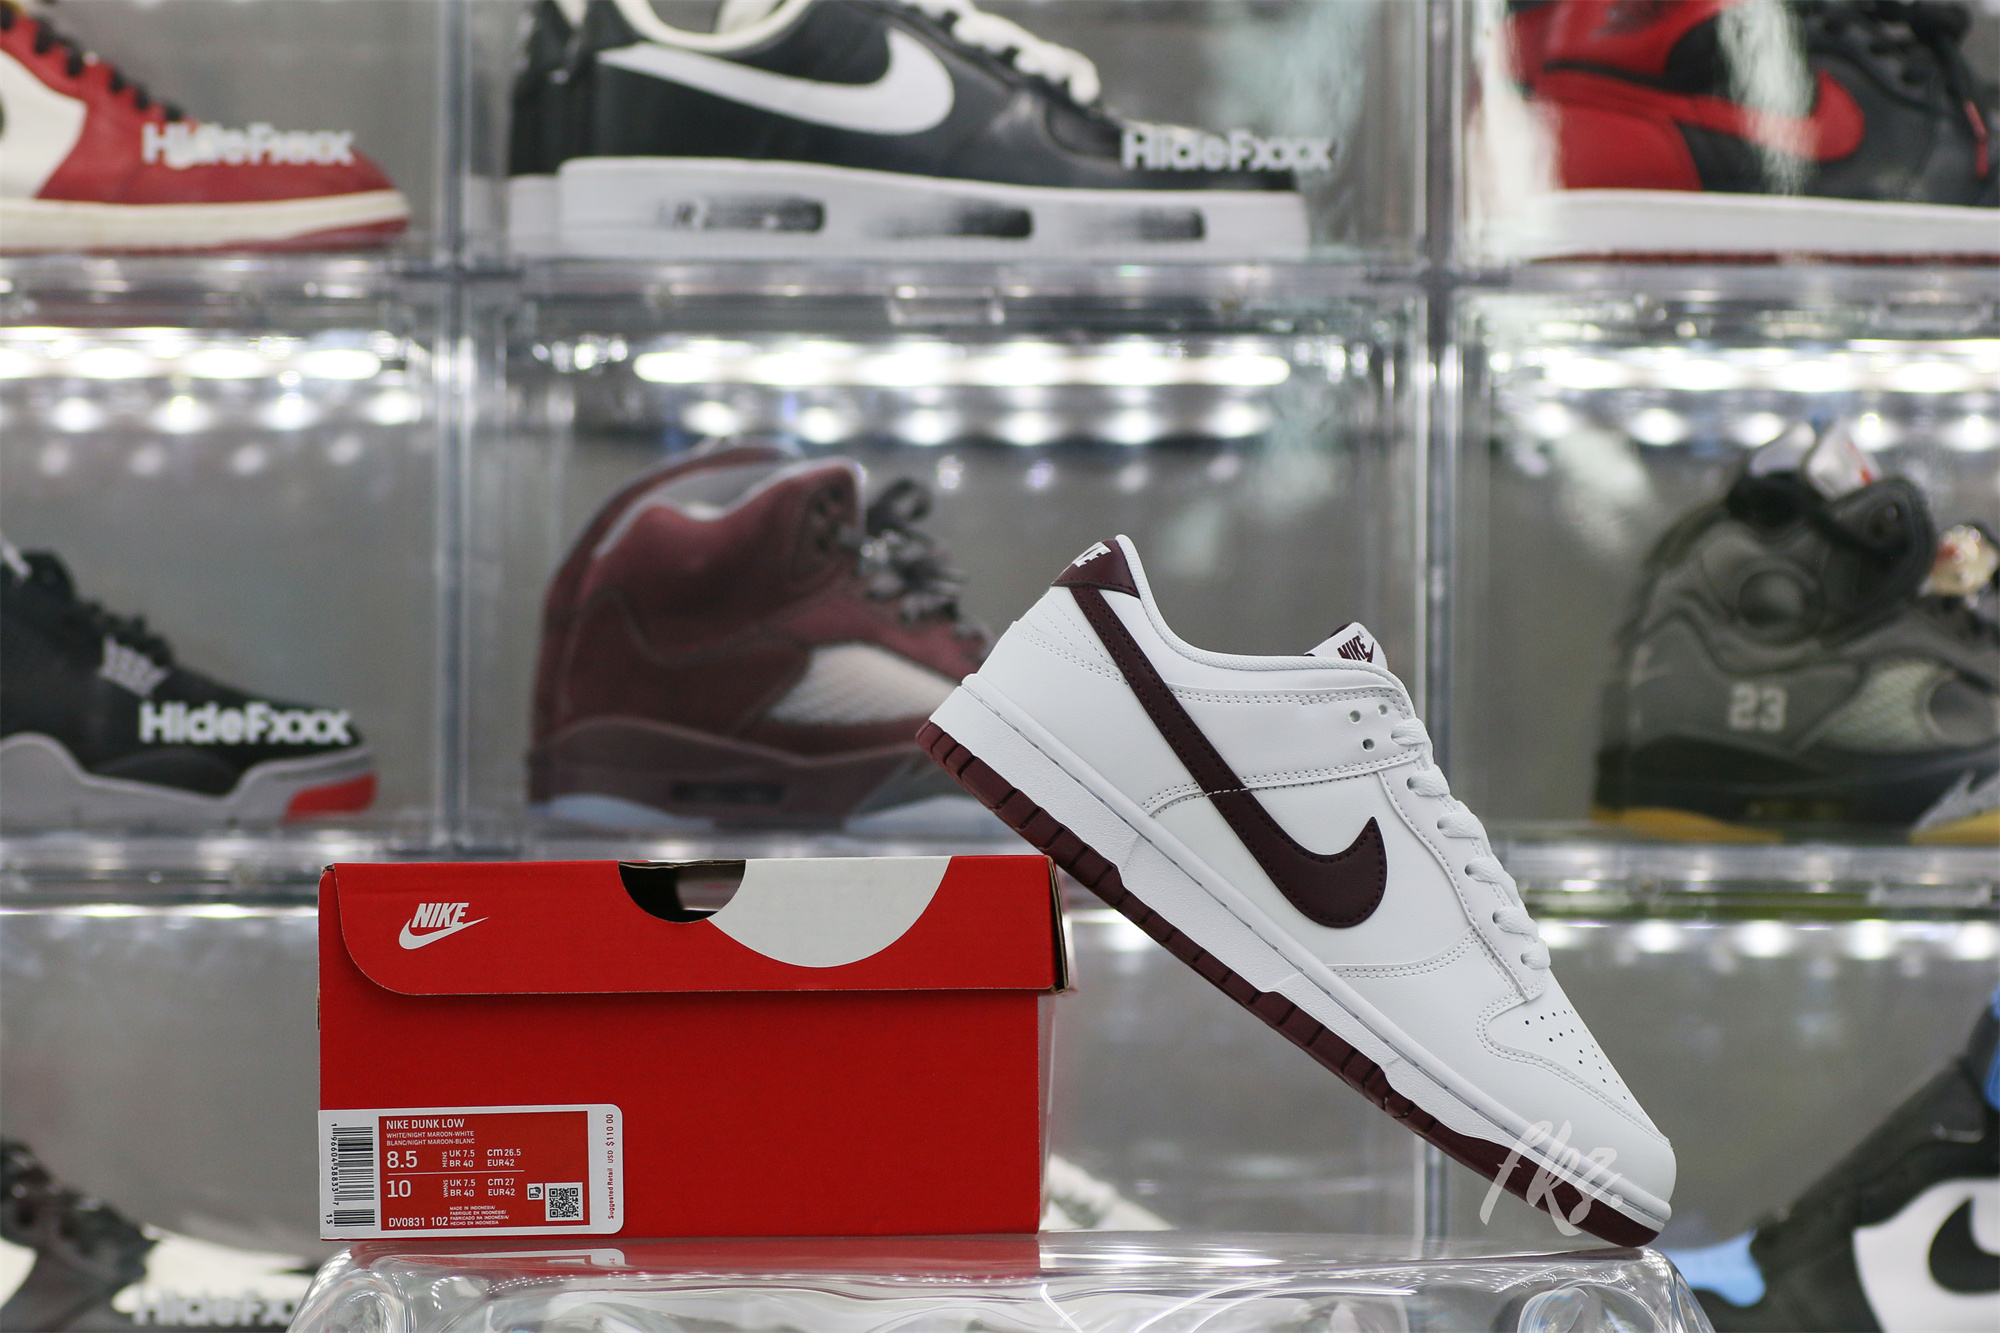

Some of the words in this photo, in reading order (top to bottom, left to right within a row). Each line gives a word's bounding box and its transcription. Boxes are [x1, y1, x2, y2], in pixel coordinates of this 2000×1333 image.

[1729, 682, 1787, 731] 23
[140, 701, 352, 745] HideFxxx
[411, 903, 469, 928] NIKE
[386, 1120, 409, 1130] NIKE
[411, 1119, 440, 1129] DUNK
[441, 1118, 465, 1128] LOW
[386, 1150, 418, 1168] 8.5
[463, 1149, 475, 1157] 7.5
[487, 1149, 503, 1157] cm
[504, 1148, 521, 1157] 26.5
[464, 1179, 476, 1187] 7.5
[488, 1178, 504, 1186] cm
[505, 1178, 515, 1186] 27
[606, 1168, 614, 1186] Retail
[386, 1180, 412, 1198] 10
[450, 1189, 462, 1197] BR
[463, 1189, 475, 1197] 40
[607, 1186, 615, 1219] Suggested
[388, 1217, 425, 1227] DV0831
[431, 1217, 448, 1226] 102
